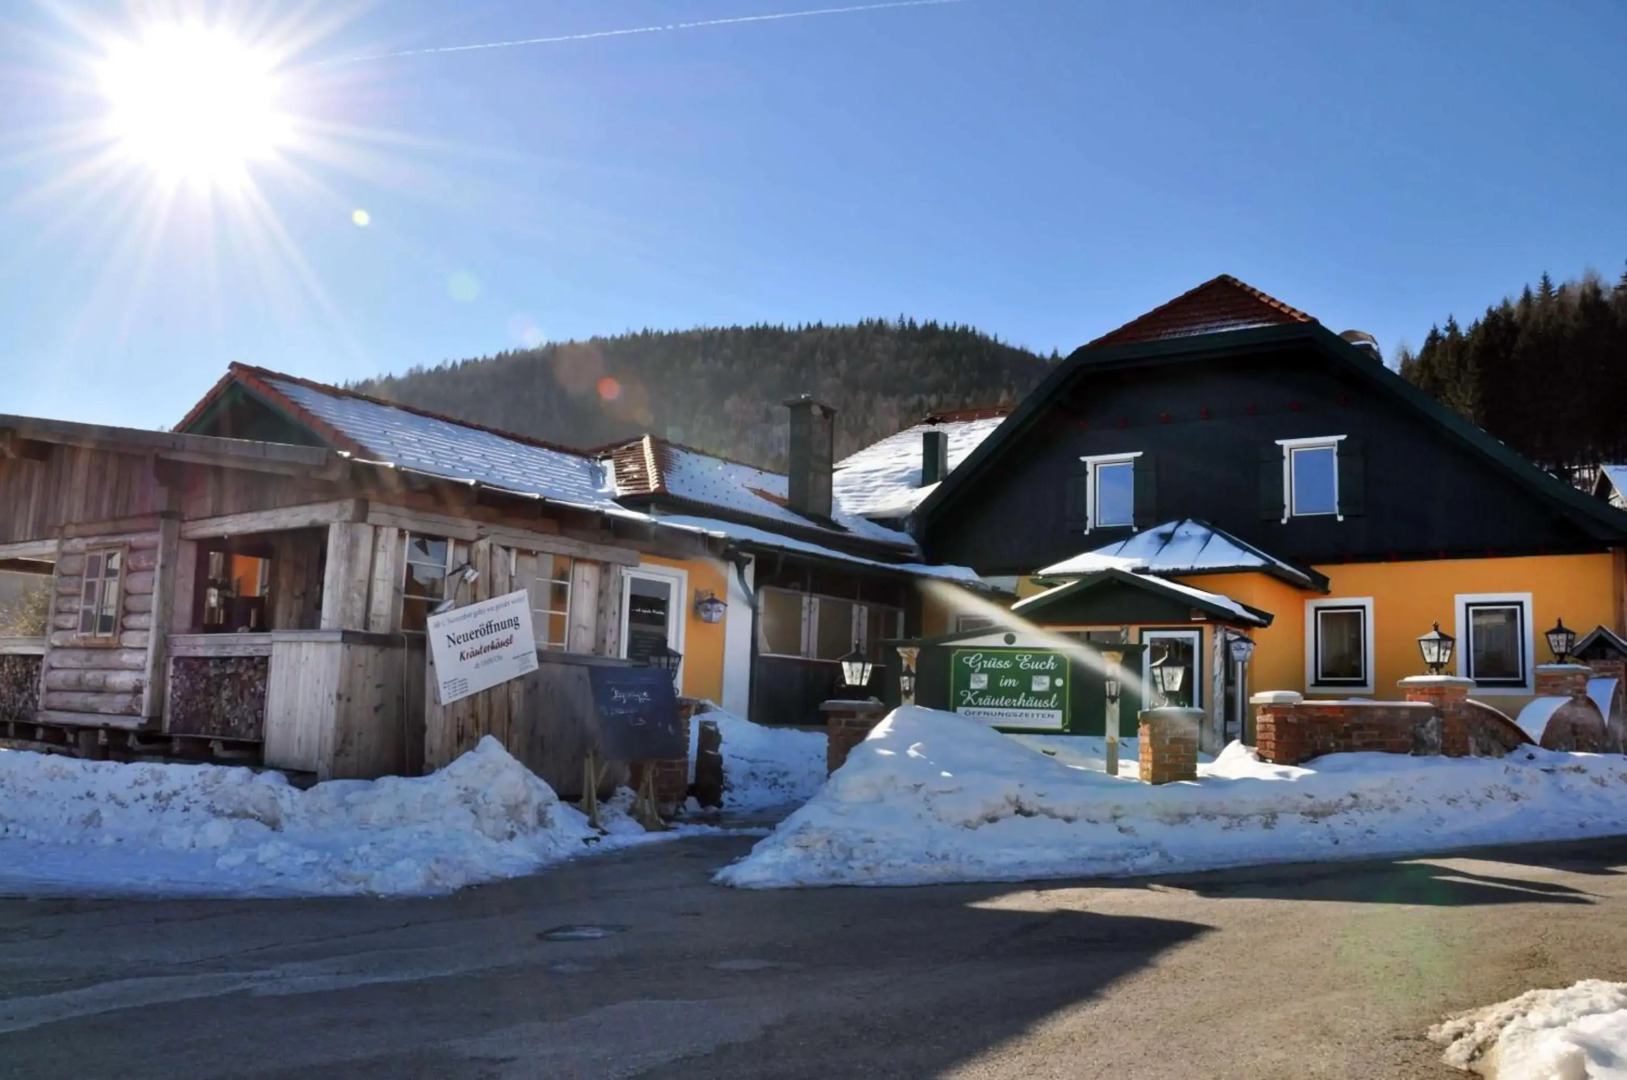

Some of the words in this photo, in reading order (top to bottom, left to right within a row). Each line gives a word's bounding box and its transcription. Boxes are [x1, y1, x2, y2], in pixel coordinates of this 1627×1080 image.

[446, 616, 520, 648] Neueröffnung
[459, 634, 513, 662] Kräuterhäusl
[963, 653, 1012, 673] Grüss
[1015, 654, 1058, 670] Euch
[999, 675, 1019, 688] im
[960, 690, 1058, 708] Kräuterhäusl
[964, 709, 1055, 719] ÖFFNUNGSZEITEN
